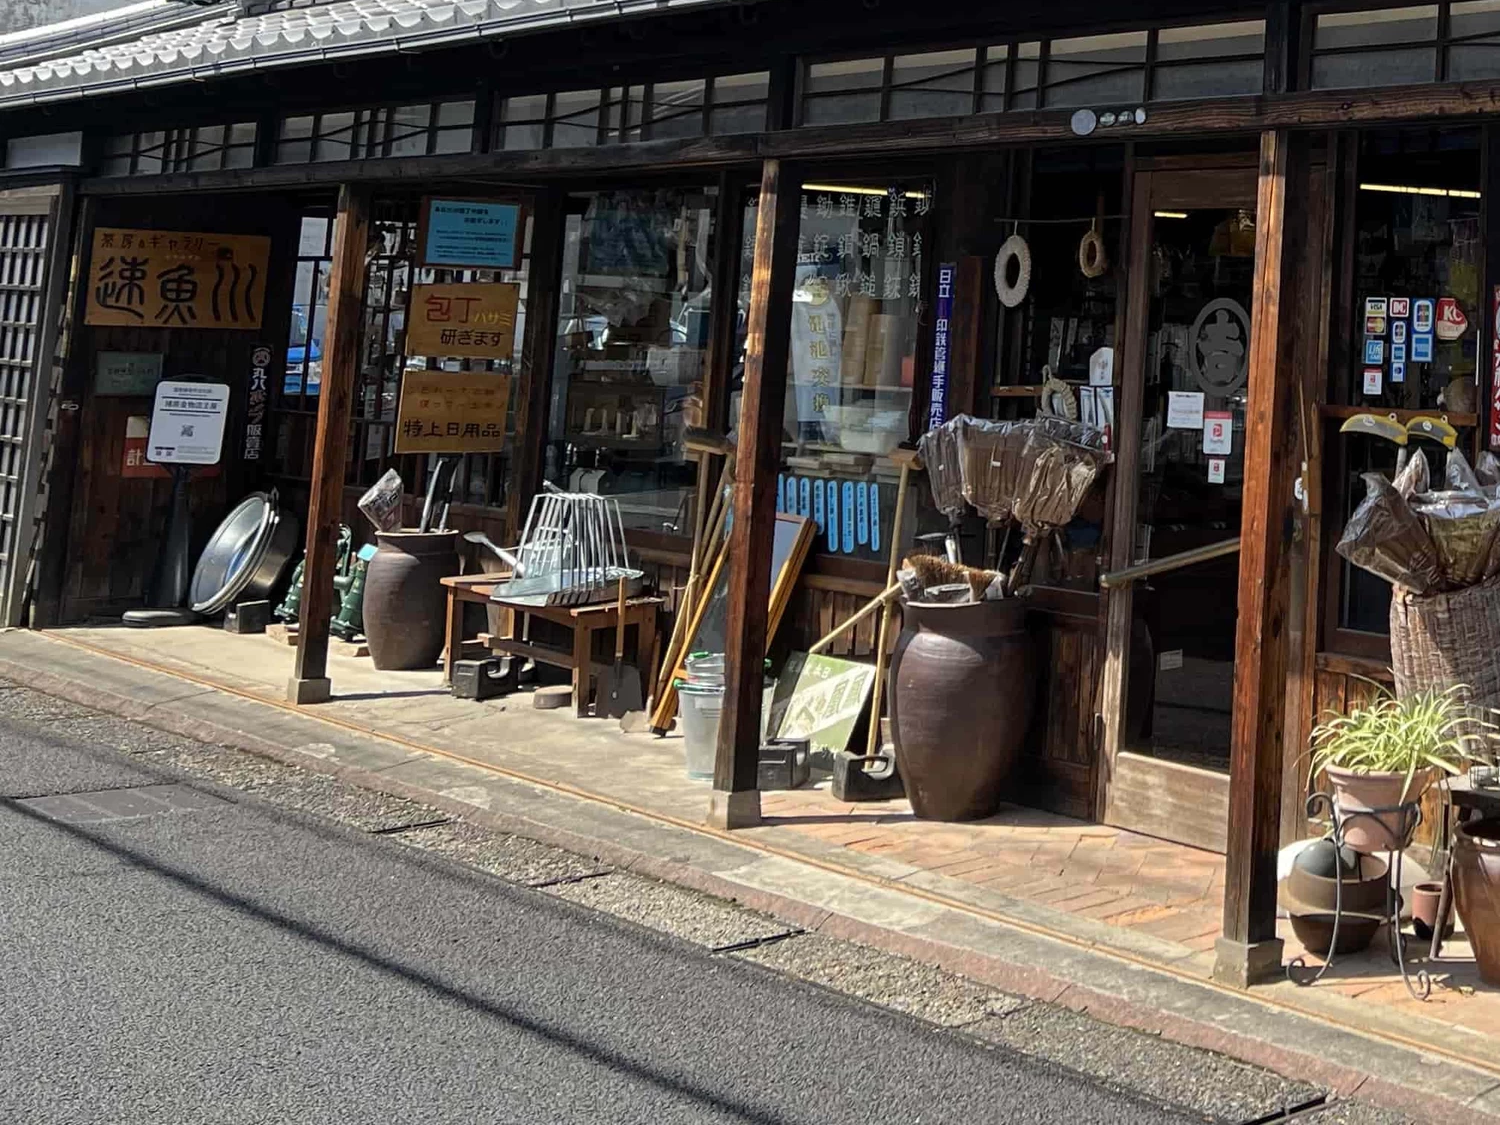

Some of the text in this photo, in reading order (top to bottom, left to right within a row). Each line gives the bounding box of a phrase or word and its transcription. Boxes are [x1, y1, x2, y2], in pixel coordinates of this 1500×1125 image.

[95, 255, 258, 325] 速魚川
[938, 269, 952, 298] 日立
[424, 293, 482, 324] 包丁
[473, 311, 513, 326] ハサミ
[440, 328, 503, 347] 研ぎます
[403, 419, 501, 439] 特上日用品
